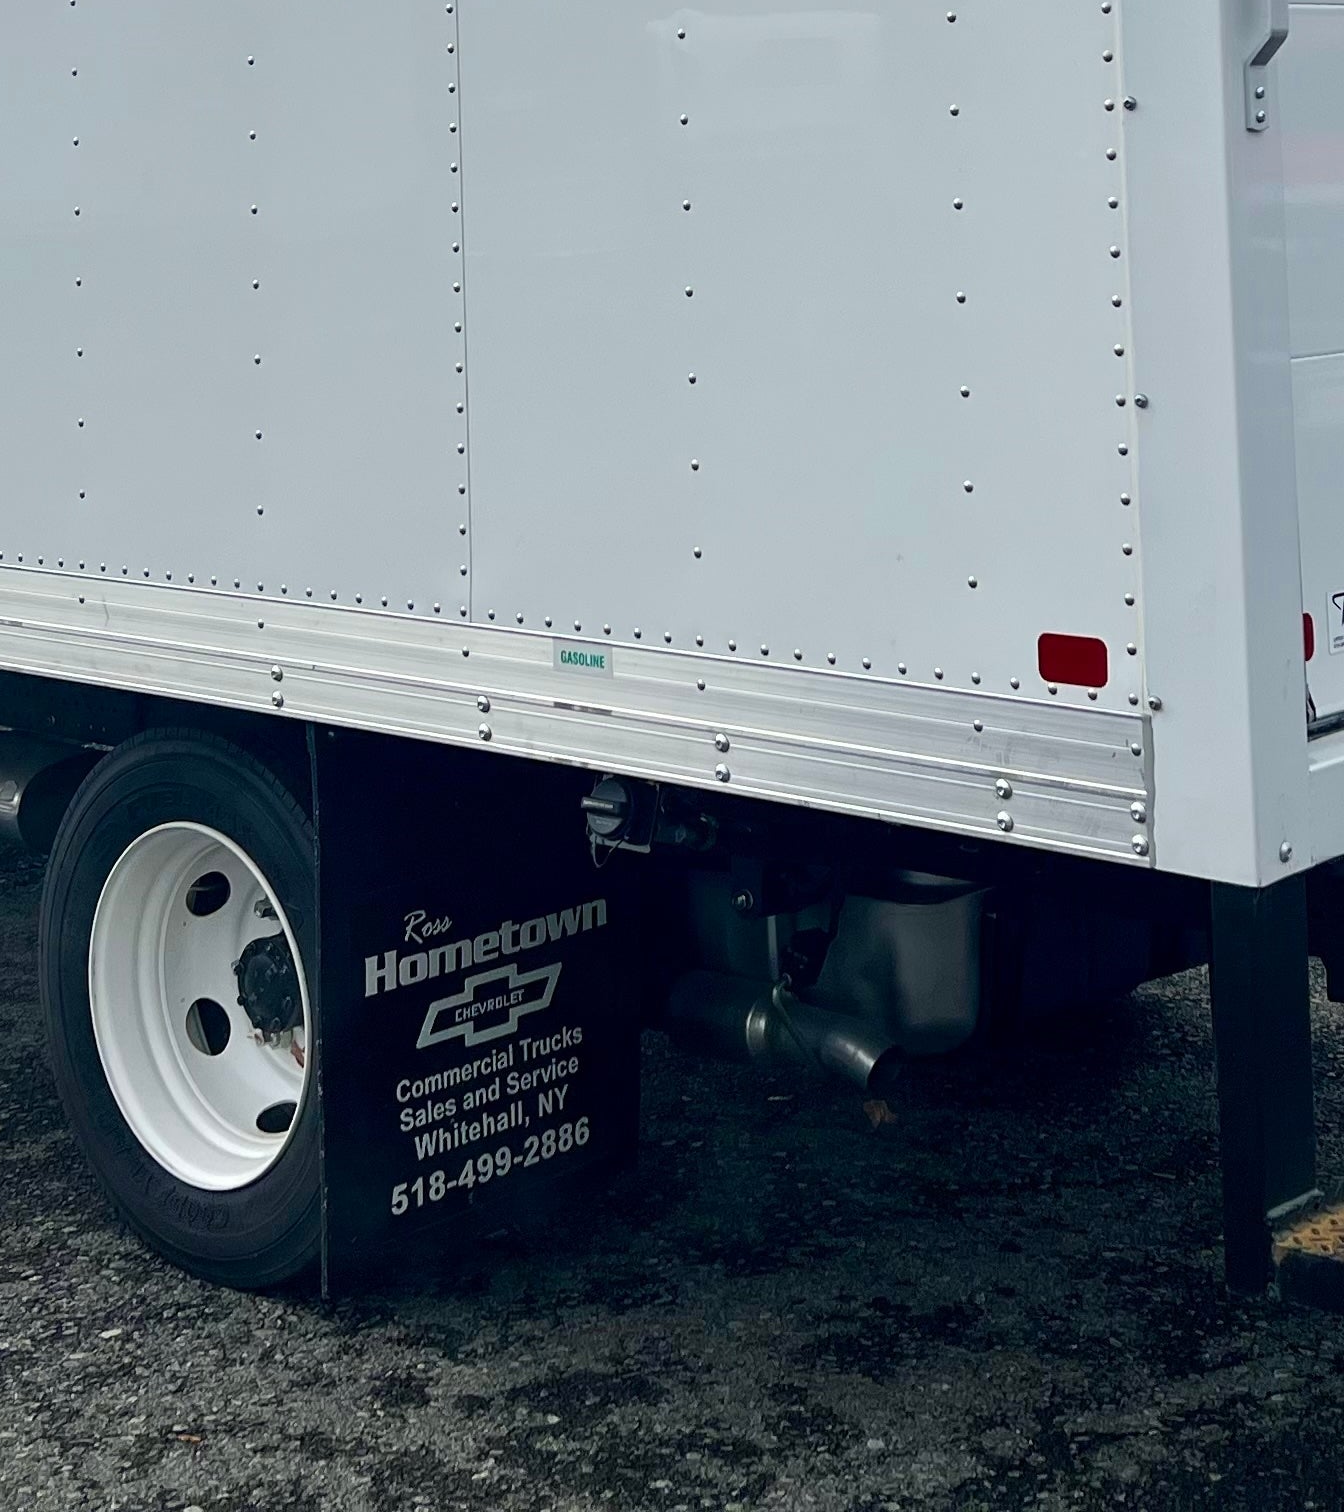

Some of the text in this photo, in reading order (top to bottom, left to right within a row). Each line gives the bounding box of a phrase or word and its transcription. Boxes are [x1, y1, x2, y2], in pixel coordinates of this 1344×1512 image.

[560, 650, 605, 669] GASOLINE
[364, 898, 607, 998] Hometown
[403, 909, 453, 944] Ross
[455, 989, 525, 1023] CHEVROLET
[396, 1026, 583, 1103] Commercial Trucks
[399, 1056, 579, 1132] Sales and Service
[414, 1084, 569, 1161] Whitehall, NY
[391, 1116, 590, 1216] 518-499-2886
